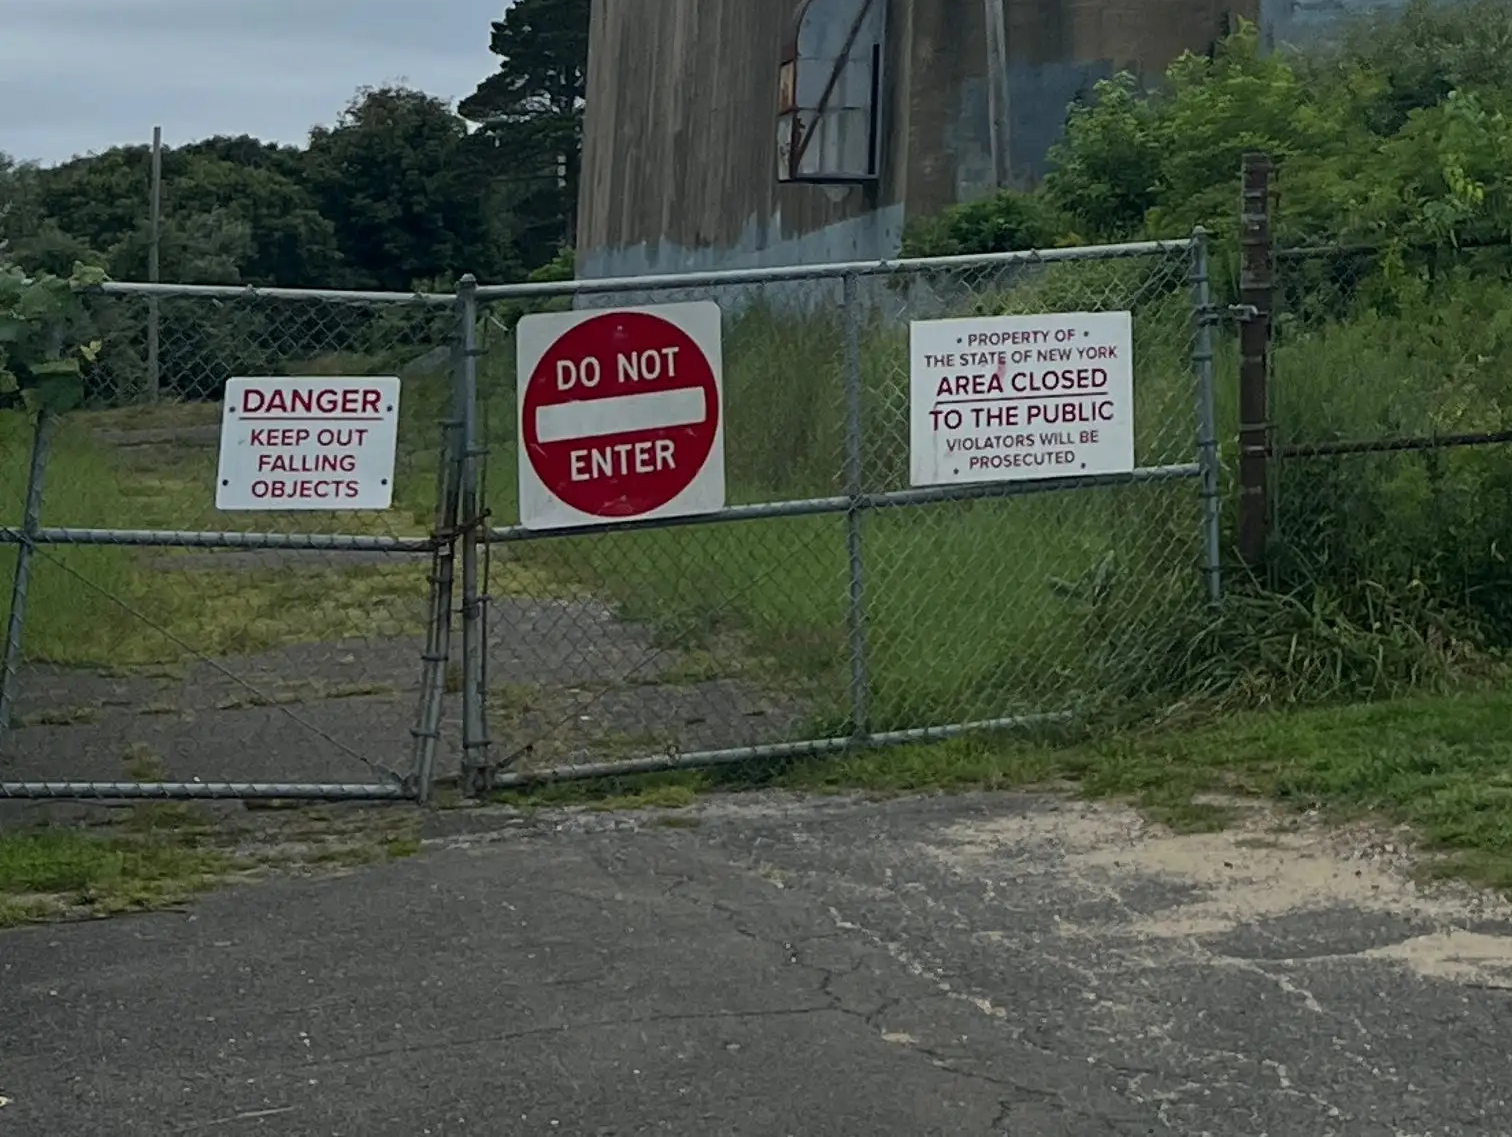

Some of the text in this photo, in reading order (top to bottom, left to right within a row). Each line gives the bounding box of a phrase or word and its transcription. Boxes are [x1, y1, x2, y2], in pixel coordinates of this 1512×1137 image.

[967, 328, 1075, 347] PROPERTY OF
[924, 346, 1118, 368] THE STATE OF NEW YORK
[556, 346, 679, 391] DO NOT
[936, 368, 1108, 397] AREA CLOSED
[242, 389, 382, 413] DANGER
[929, 400, 1114, 431] TO THE PUBLIC
[250, 429, 368, 446] KEEP OUT
[946, 430, 1099, 452] VIOLATORS WILL BE
[258, 454, 356, 472] FALLING
[570, 439, 676, 481] ENTER
[969, 450, 1075, 470] PROSECUTED
[251, 480, 359, 498] OBJECTS
